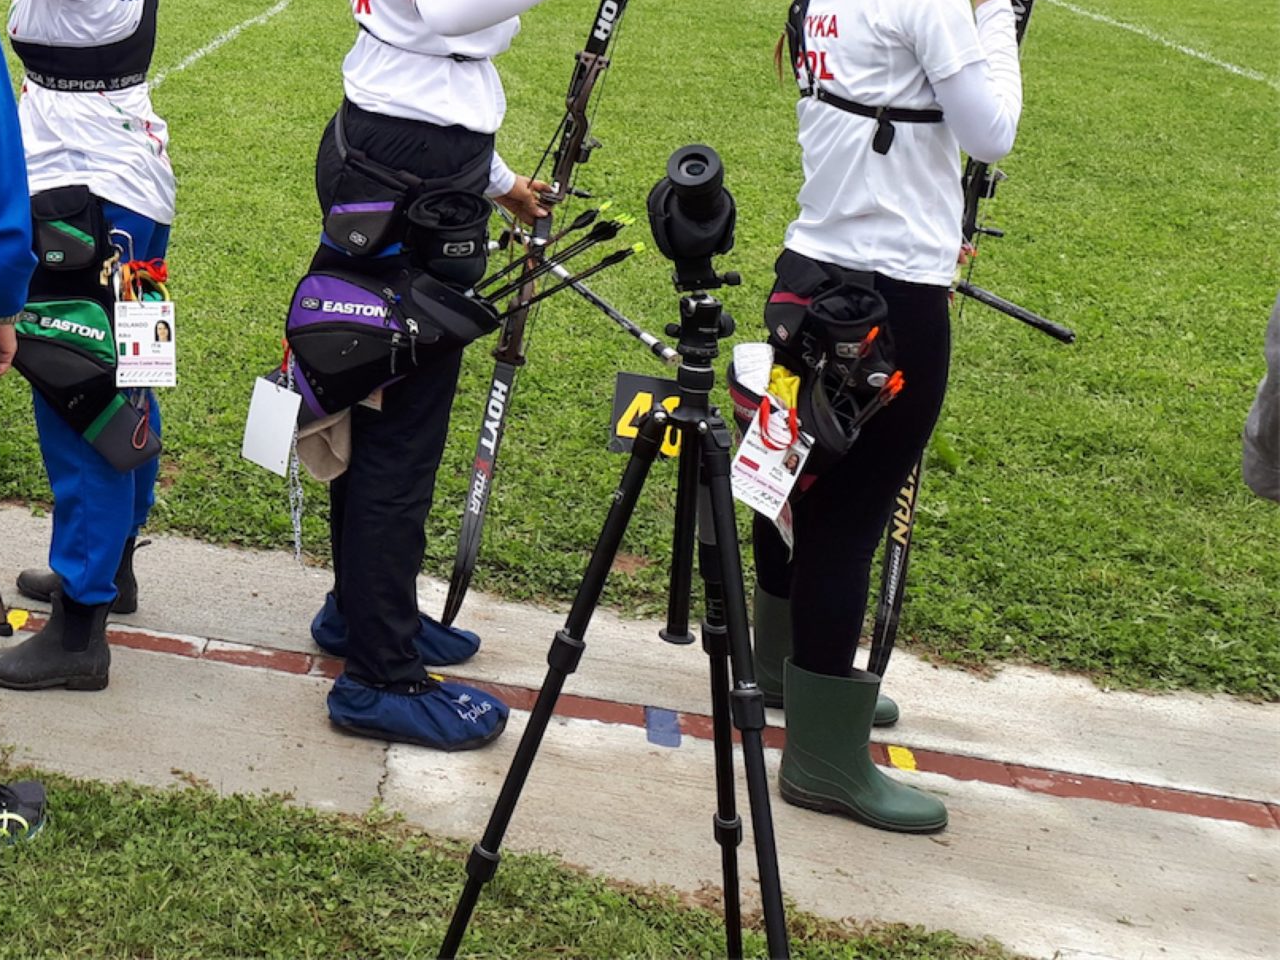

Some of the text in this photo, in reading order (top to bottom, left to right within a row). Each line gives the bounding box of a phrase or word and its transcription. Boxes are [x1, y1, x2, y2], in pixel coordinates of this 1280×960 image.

[58, 79, 106, 90] SPIGA
[323, 301, 388, 318] EASTON
[40, 316, 105, 341] EASTON
[480, 379, 509, 455] HOYT
